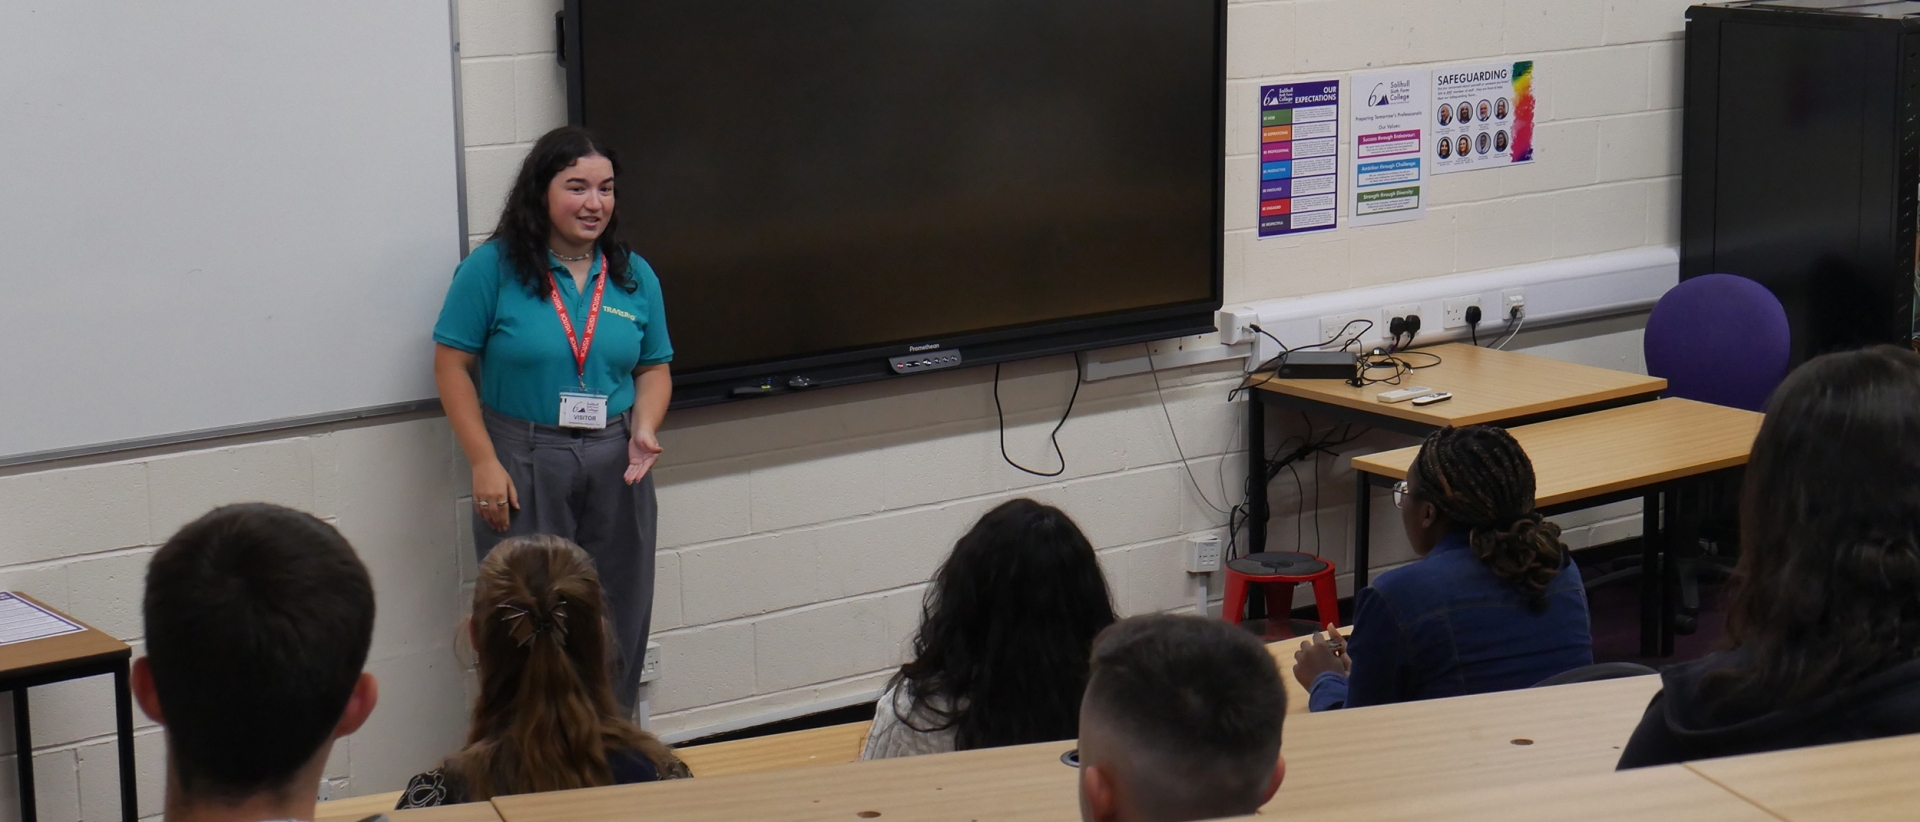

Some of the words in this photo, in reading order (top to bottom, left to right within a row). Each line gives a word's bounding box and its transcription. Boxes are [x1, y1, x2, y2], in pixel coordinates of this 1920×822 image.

[1390, 80, 1410, 88] Solihull
[1438, 69, 1507, 86] SAFEGUARDING
[1295, 94, 1336, 103] EXPECTATIONS
[591, 293, 600, 312] VISITOR
[560, 313, 572, 334] VISITOR
[586, 315, 596, 334] VISITOR
[580, 337, 590, 358] VISITOR
[910, 344, 939, 352] Promethean
